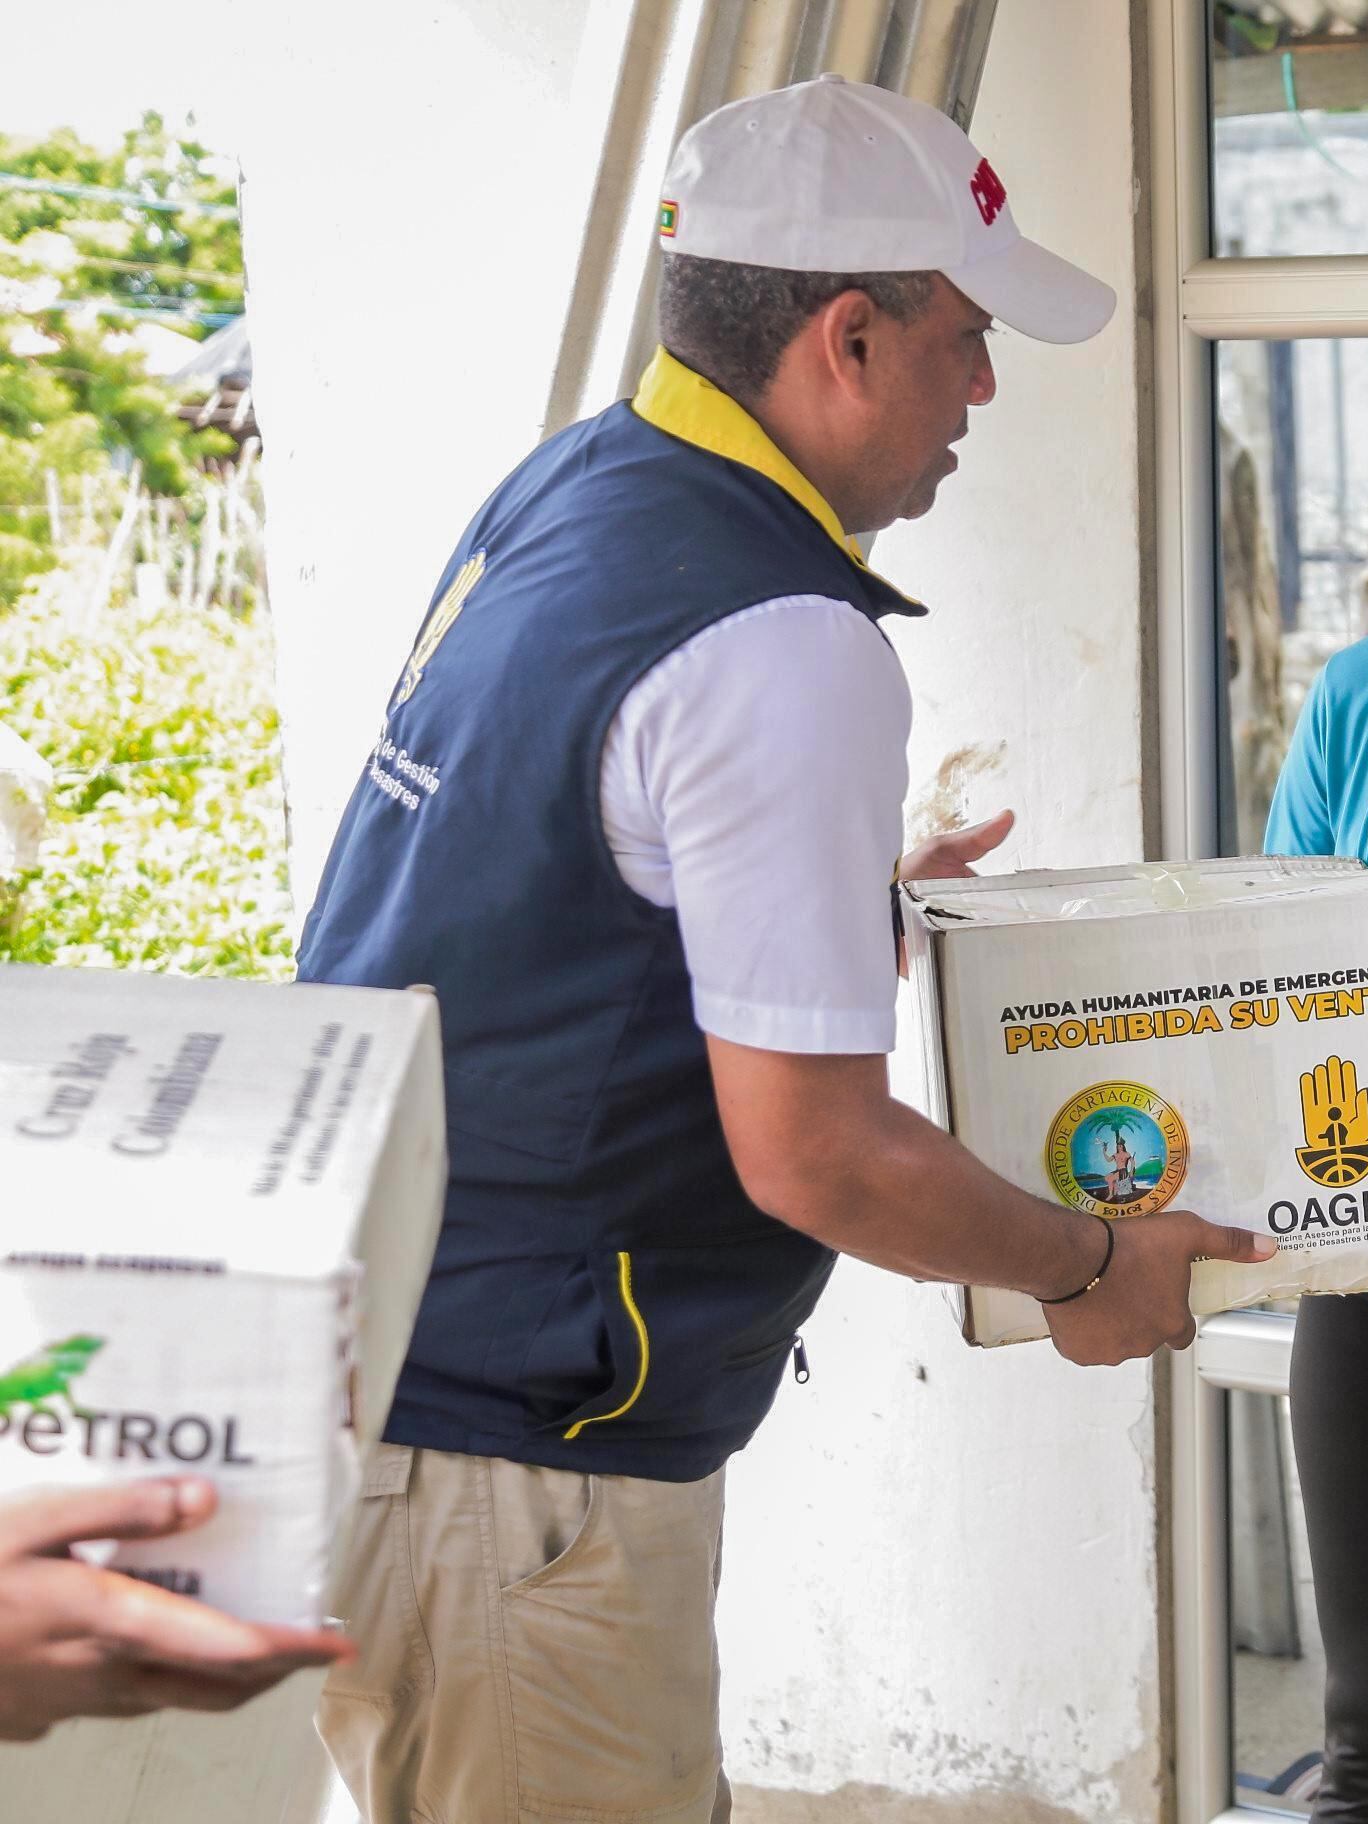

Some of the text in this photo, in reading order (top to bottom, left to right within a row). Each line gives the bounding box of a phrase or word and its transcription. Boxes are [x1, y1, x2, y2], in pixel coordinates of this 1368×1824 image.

[381, 738, 397, 760] de
[397, 749, 440, 795] Gestión
[1000, 1000, 1077, 1022] AYUDA
[1082, 983, 1234, 1014] HUMANITARIA
[1239, 979, 1269, 997] DE
[1004, 1005, 1224, 1054] PROHIBIDA
[1229, 997, 1280, 1030] SU
[1055, 1089, 1182, 1212] DISTRITO DE CARTAGENA DE INDIAS
[1277, 1243, 1304, 1252] Riesgo
[1306, 1240, 1317, 1248] de
[1319, 1235, 1361, 1247] Desastres
[1304, 1229, 1340, 1240] Asesora
[1342, 1227, 1361, 1236] para
